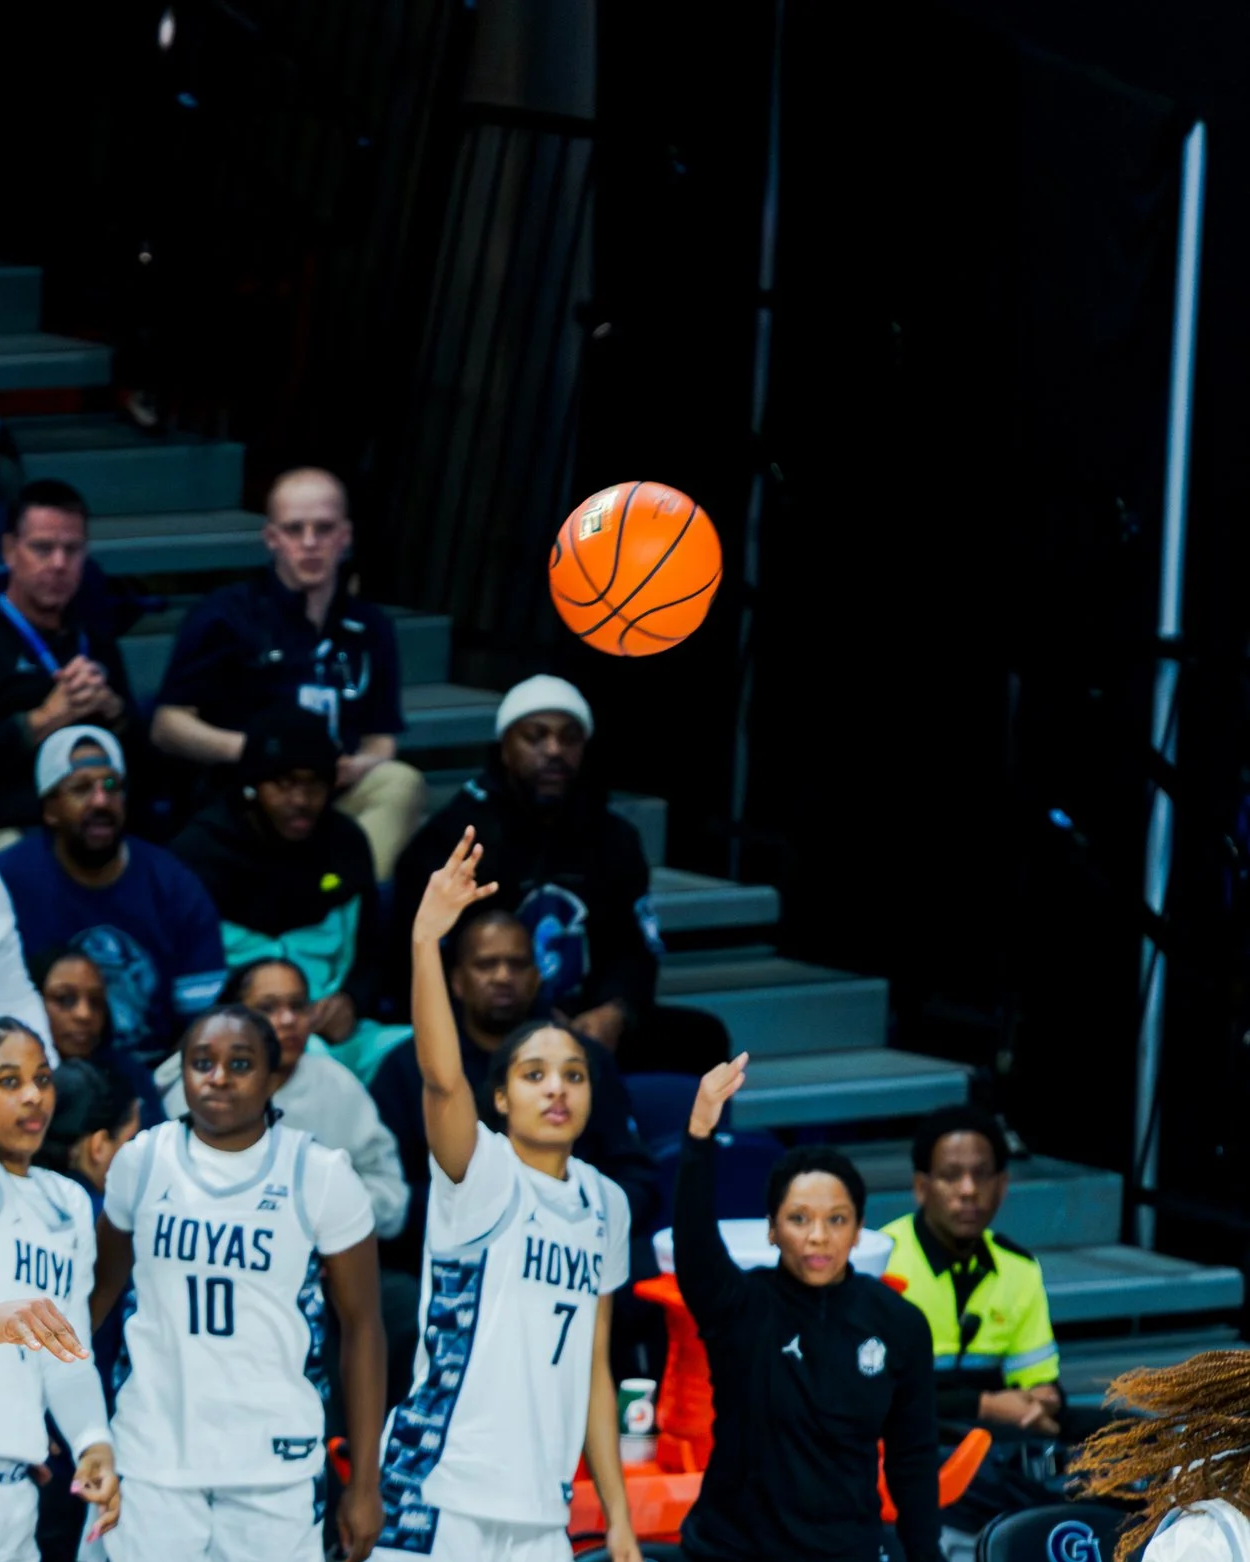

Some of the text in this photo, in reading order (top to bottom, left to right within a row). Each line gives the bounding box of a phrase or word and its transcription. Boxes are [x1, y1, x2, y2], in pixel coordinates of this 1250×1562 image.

[153, 1214, 274, 1272] HOYAS
[523, 1236, 602, 1296] HOYAS
[186, 1275, 235, 1337] 10
[551, 1302, 578, 1366] 7
